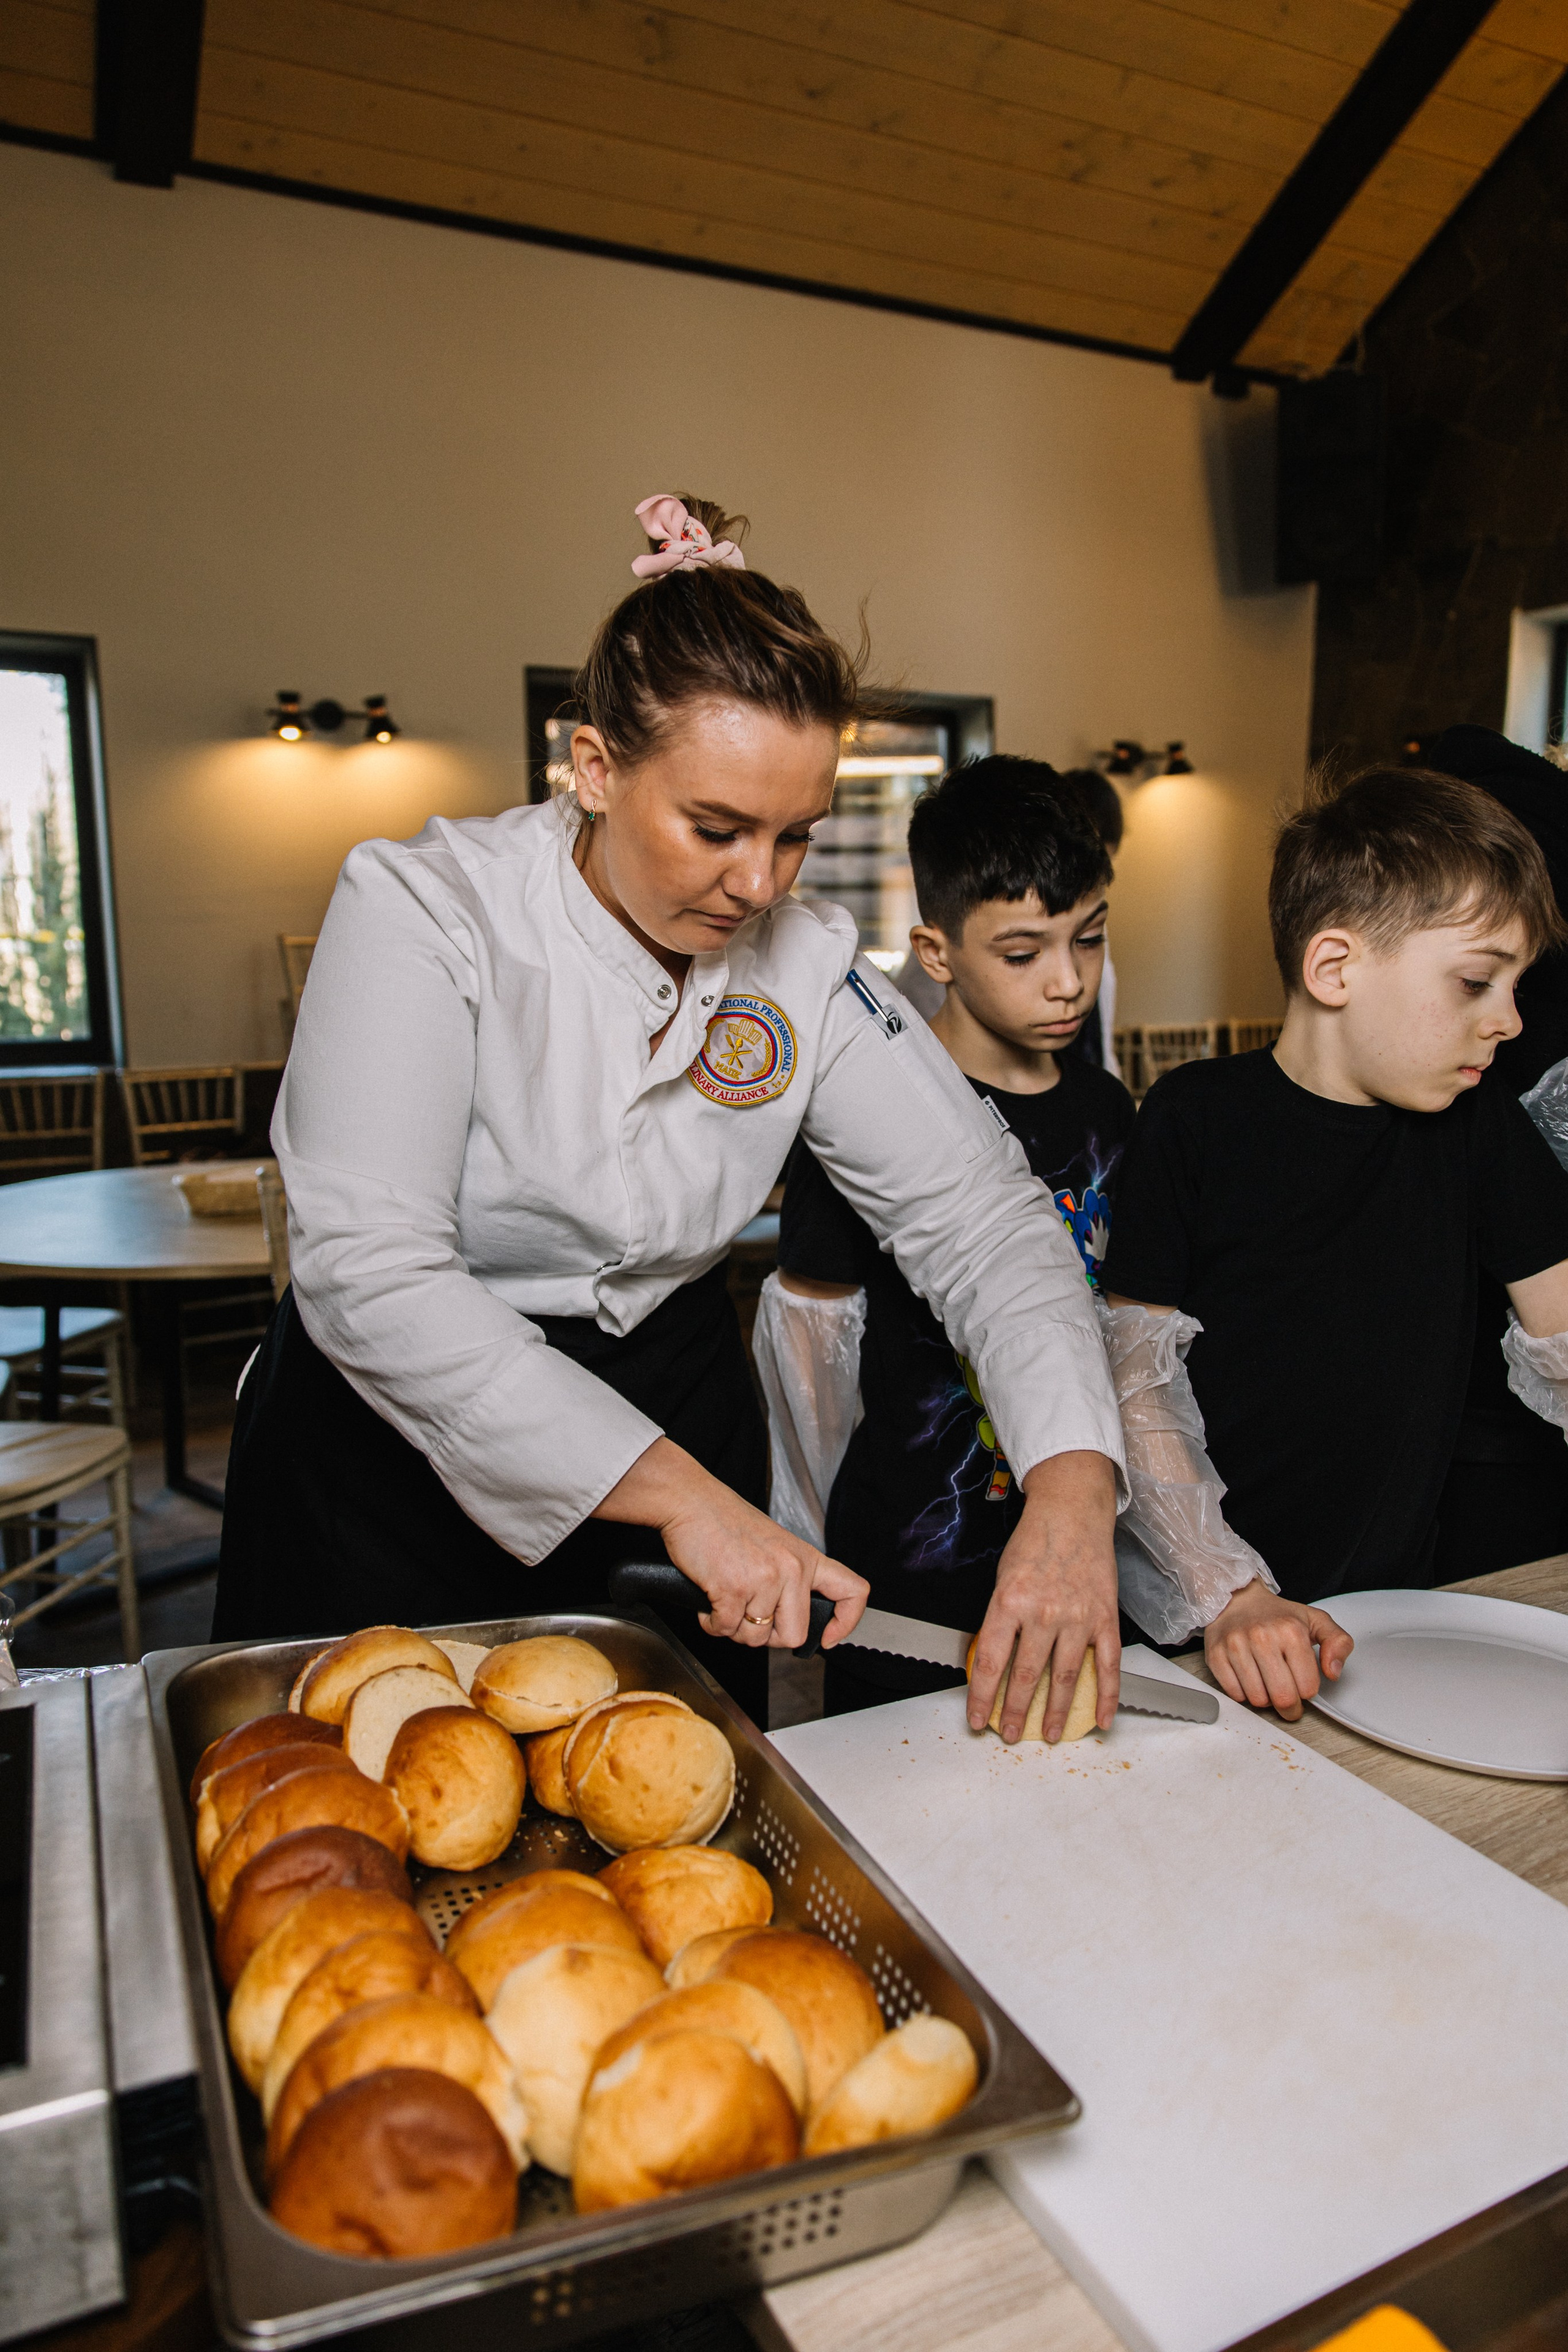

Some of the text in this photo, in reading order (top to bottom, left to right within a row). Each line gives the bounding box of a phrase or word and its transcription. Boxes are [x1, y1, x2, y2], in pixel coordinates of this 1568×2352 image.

[718, 999, 792, 1072] ATIONAL PROFESSIONAL
[689, 1060, 769, 1101] LINARY ALLIANCE
[989, 1105, 1006, 1128] PITERPROF
